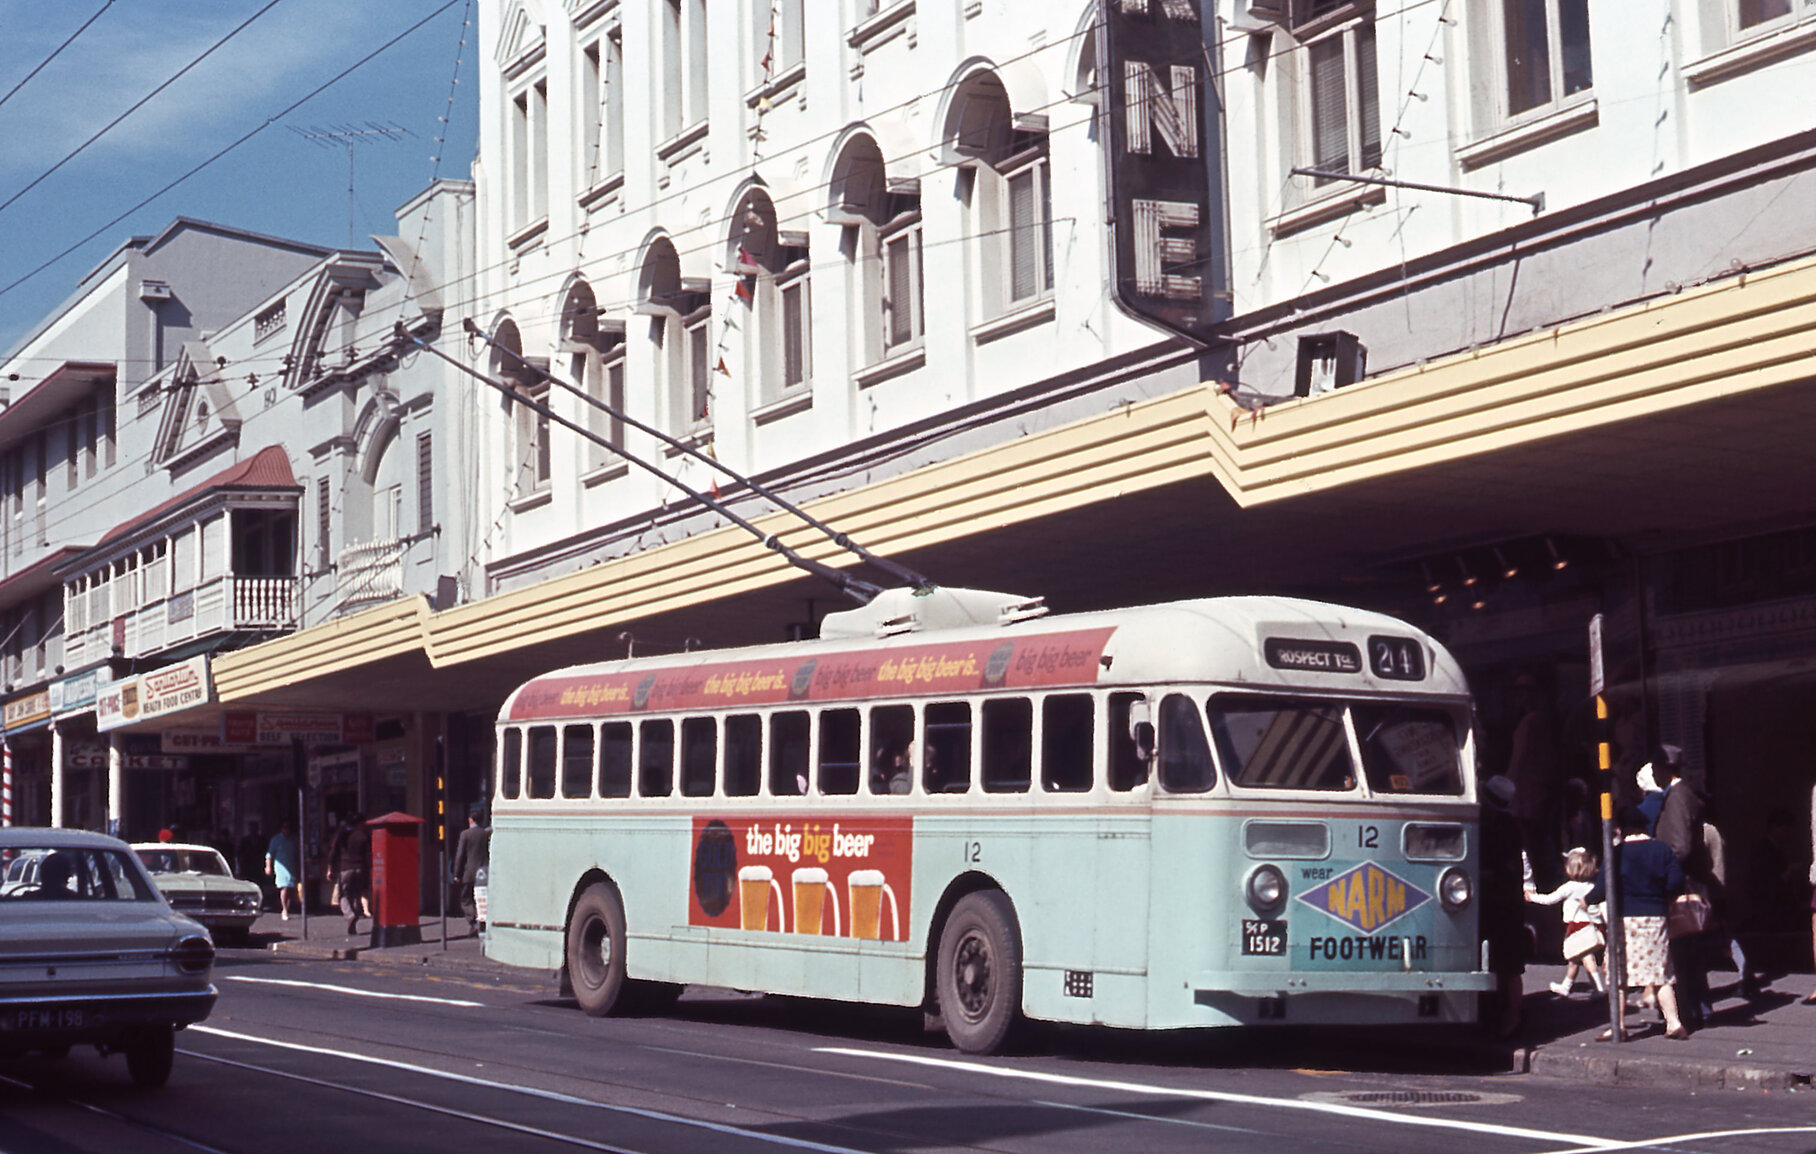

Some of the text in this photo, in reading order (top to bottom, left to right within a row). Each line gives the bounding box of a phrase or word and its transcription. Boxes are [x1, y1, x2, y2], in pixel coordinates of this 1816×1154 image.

[71, 755, 181, 767] CAKET
[746, 824, 773, 855] the
[774, 823, 801, 863] big
[803, 823, 831, 863] big
[832, 823, 874, 857] beer
[1358, 825, 1379, 848] 12
[964, 842, 982, 863] 12
[1301, 867, 1333, 880] wear
[1328, 866, 1405, 929] NARM
[1249, 935, 1280, 953] 1512
[1310, 935, 1426, 960] FOOTWEAR
